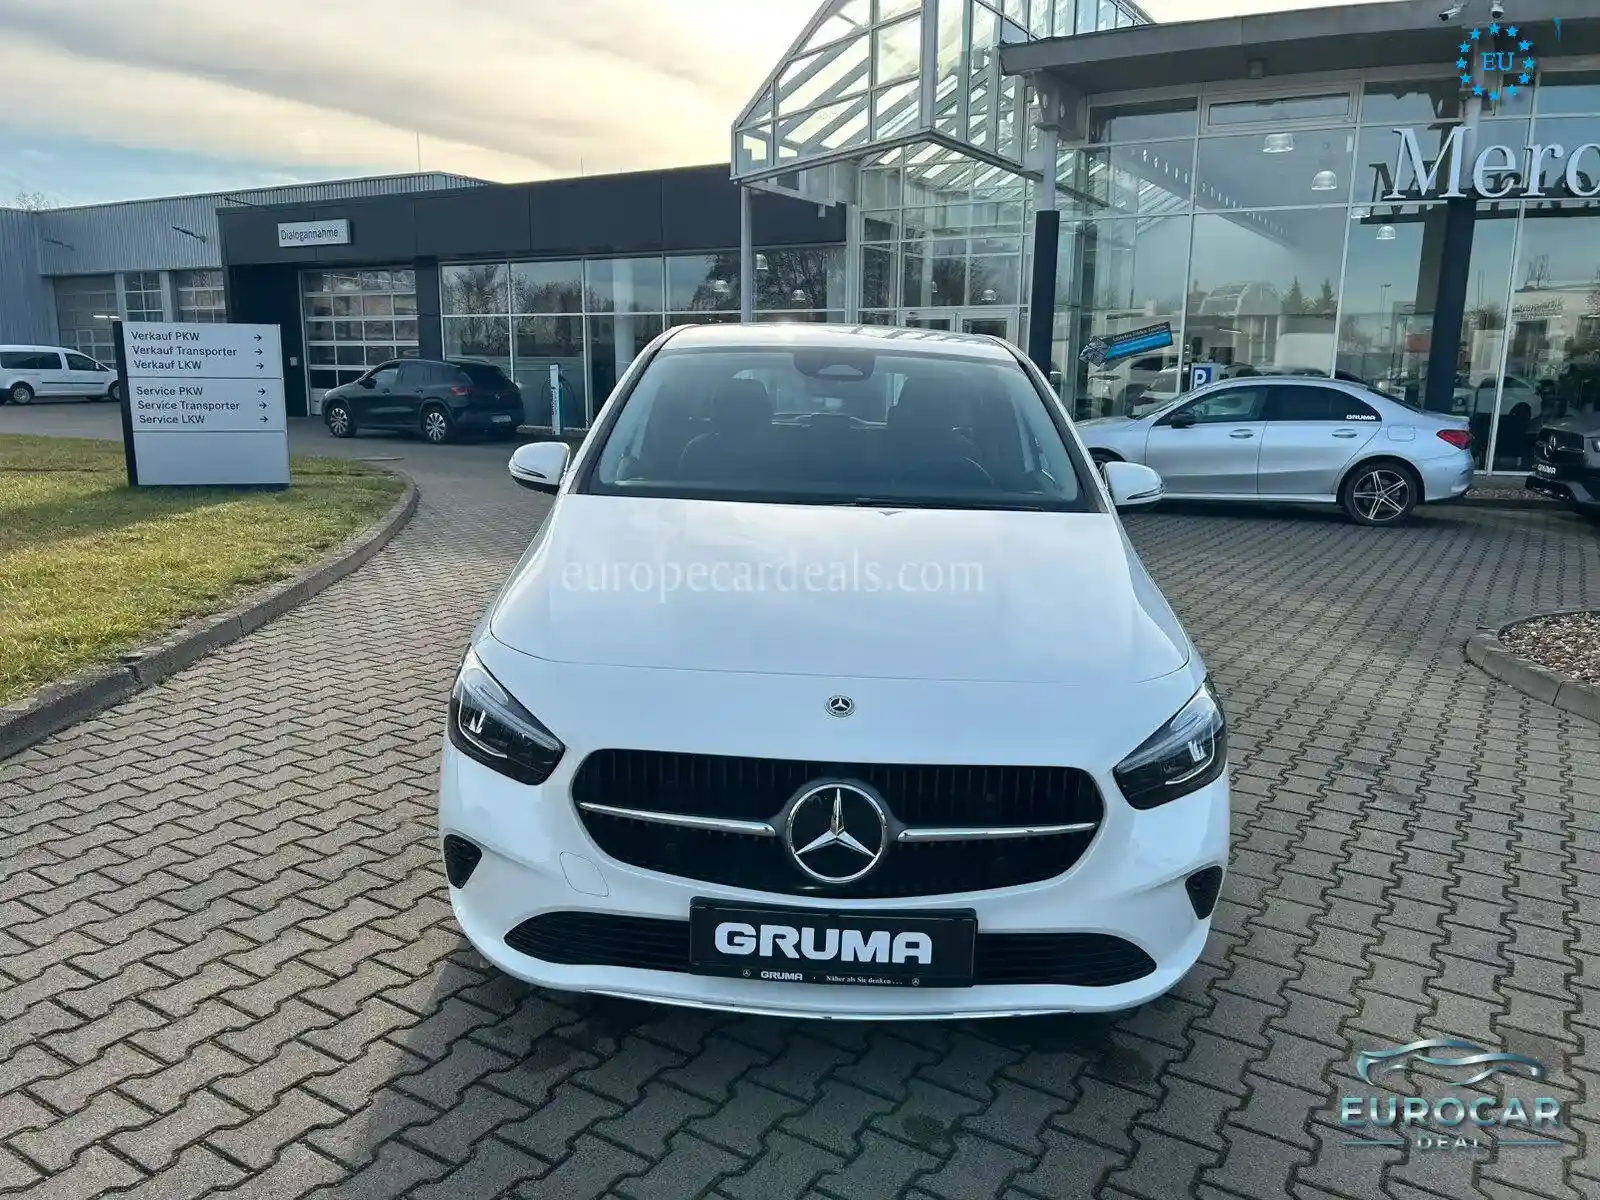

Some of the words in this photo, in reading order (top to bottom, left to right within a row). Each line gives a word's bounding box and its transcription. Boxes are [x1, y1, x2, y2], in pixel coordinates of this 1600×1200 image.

[1383, 126, 1600, 199] Merc
[281, 228, 339, 241] Dialogannahme
[131, 331, 172, 341] Verkauf
[175, 332, 200, 341] PKW
[132, 345, 173, 355] Verkauf
[177, 346, 237, 358] Transporter
[134, 360, 175, 369] Verkauf
[178, 360, 202, 369] LKW
[1194, 369, 1207, 388] P
[136, 386, 176, 396] Service
[179, 387, 203, 396] PKW
[137, 400, 177, 410] Service
[181, 401, 240, 412] Transporter
[139, 415, 179, 424] Service
[182, 415, 205, 424] LKW
[714, 921, 933, 965] GRUMA
[760, 970, 803, 981] GRUMA
